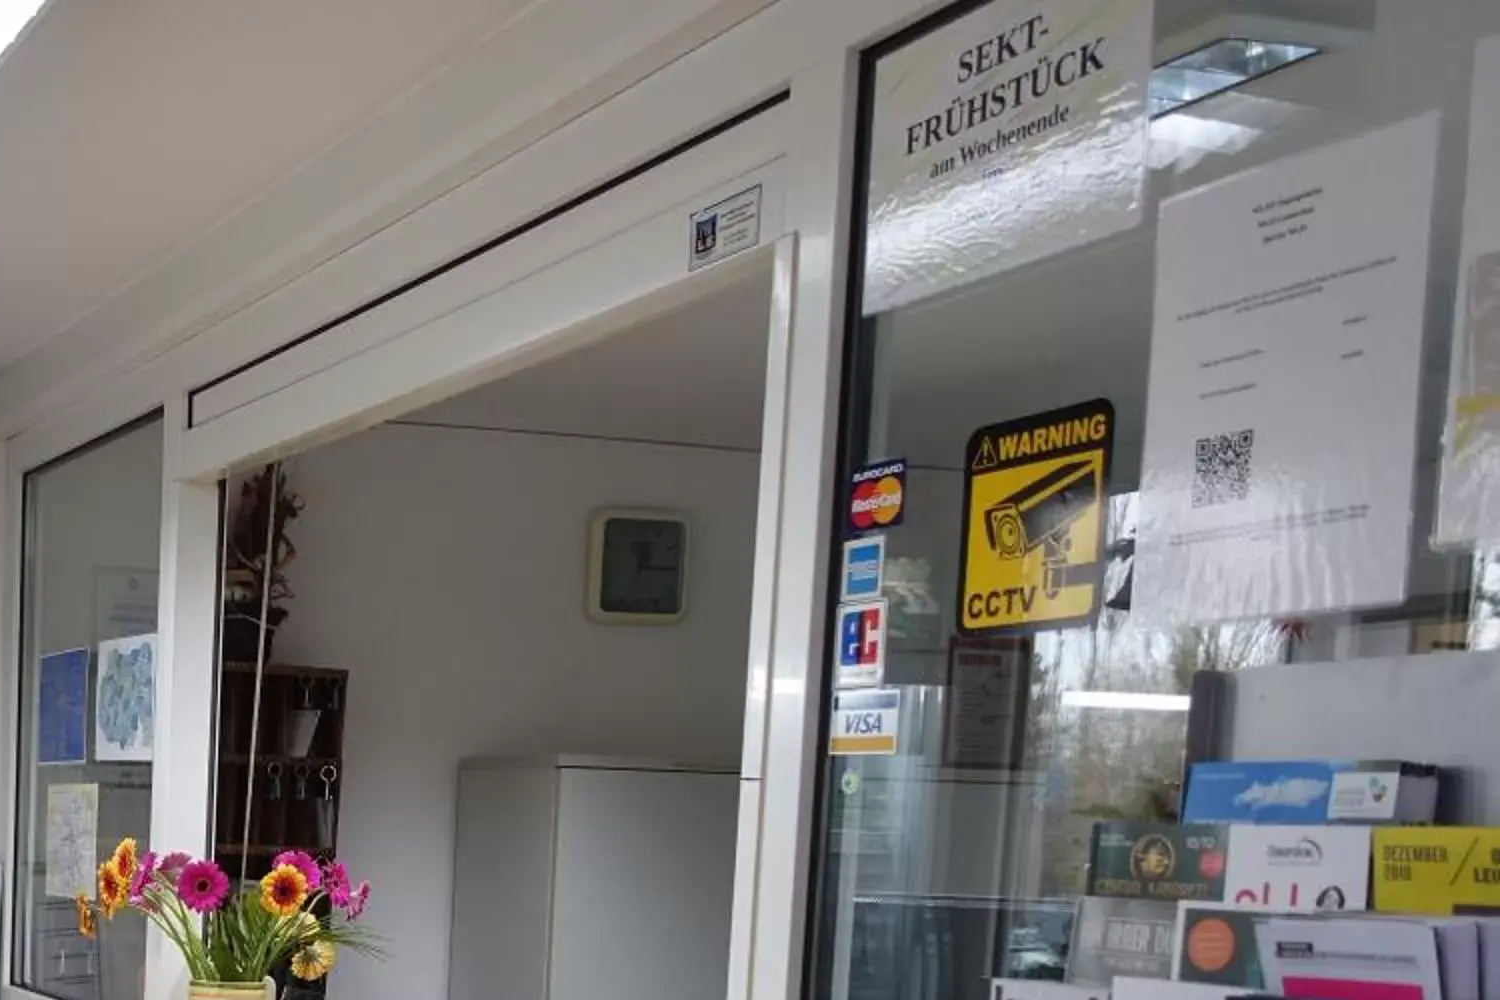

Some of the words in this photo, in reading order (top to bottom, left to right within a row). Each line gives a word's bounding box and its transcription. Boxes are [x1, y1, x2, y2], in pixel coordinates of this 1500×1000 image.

[957, 14, 1050, 84] SEKT-
[906, 36, 1107, 156] FRÜHSTÜCK
[930, 155, 956, 178] am
[960, 103, 1071, 165] Wochenende
[999, 414, 1107, 462] WARNING
[967, 585, 1037, 620] CCTV
[845, 712, 882, 734] VISA
[1383, 845, 1448, 862] DEZEMBER
